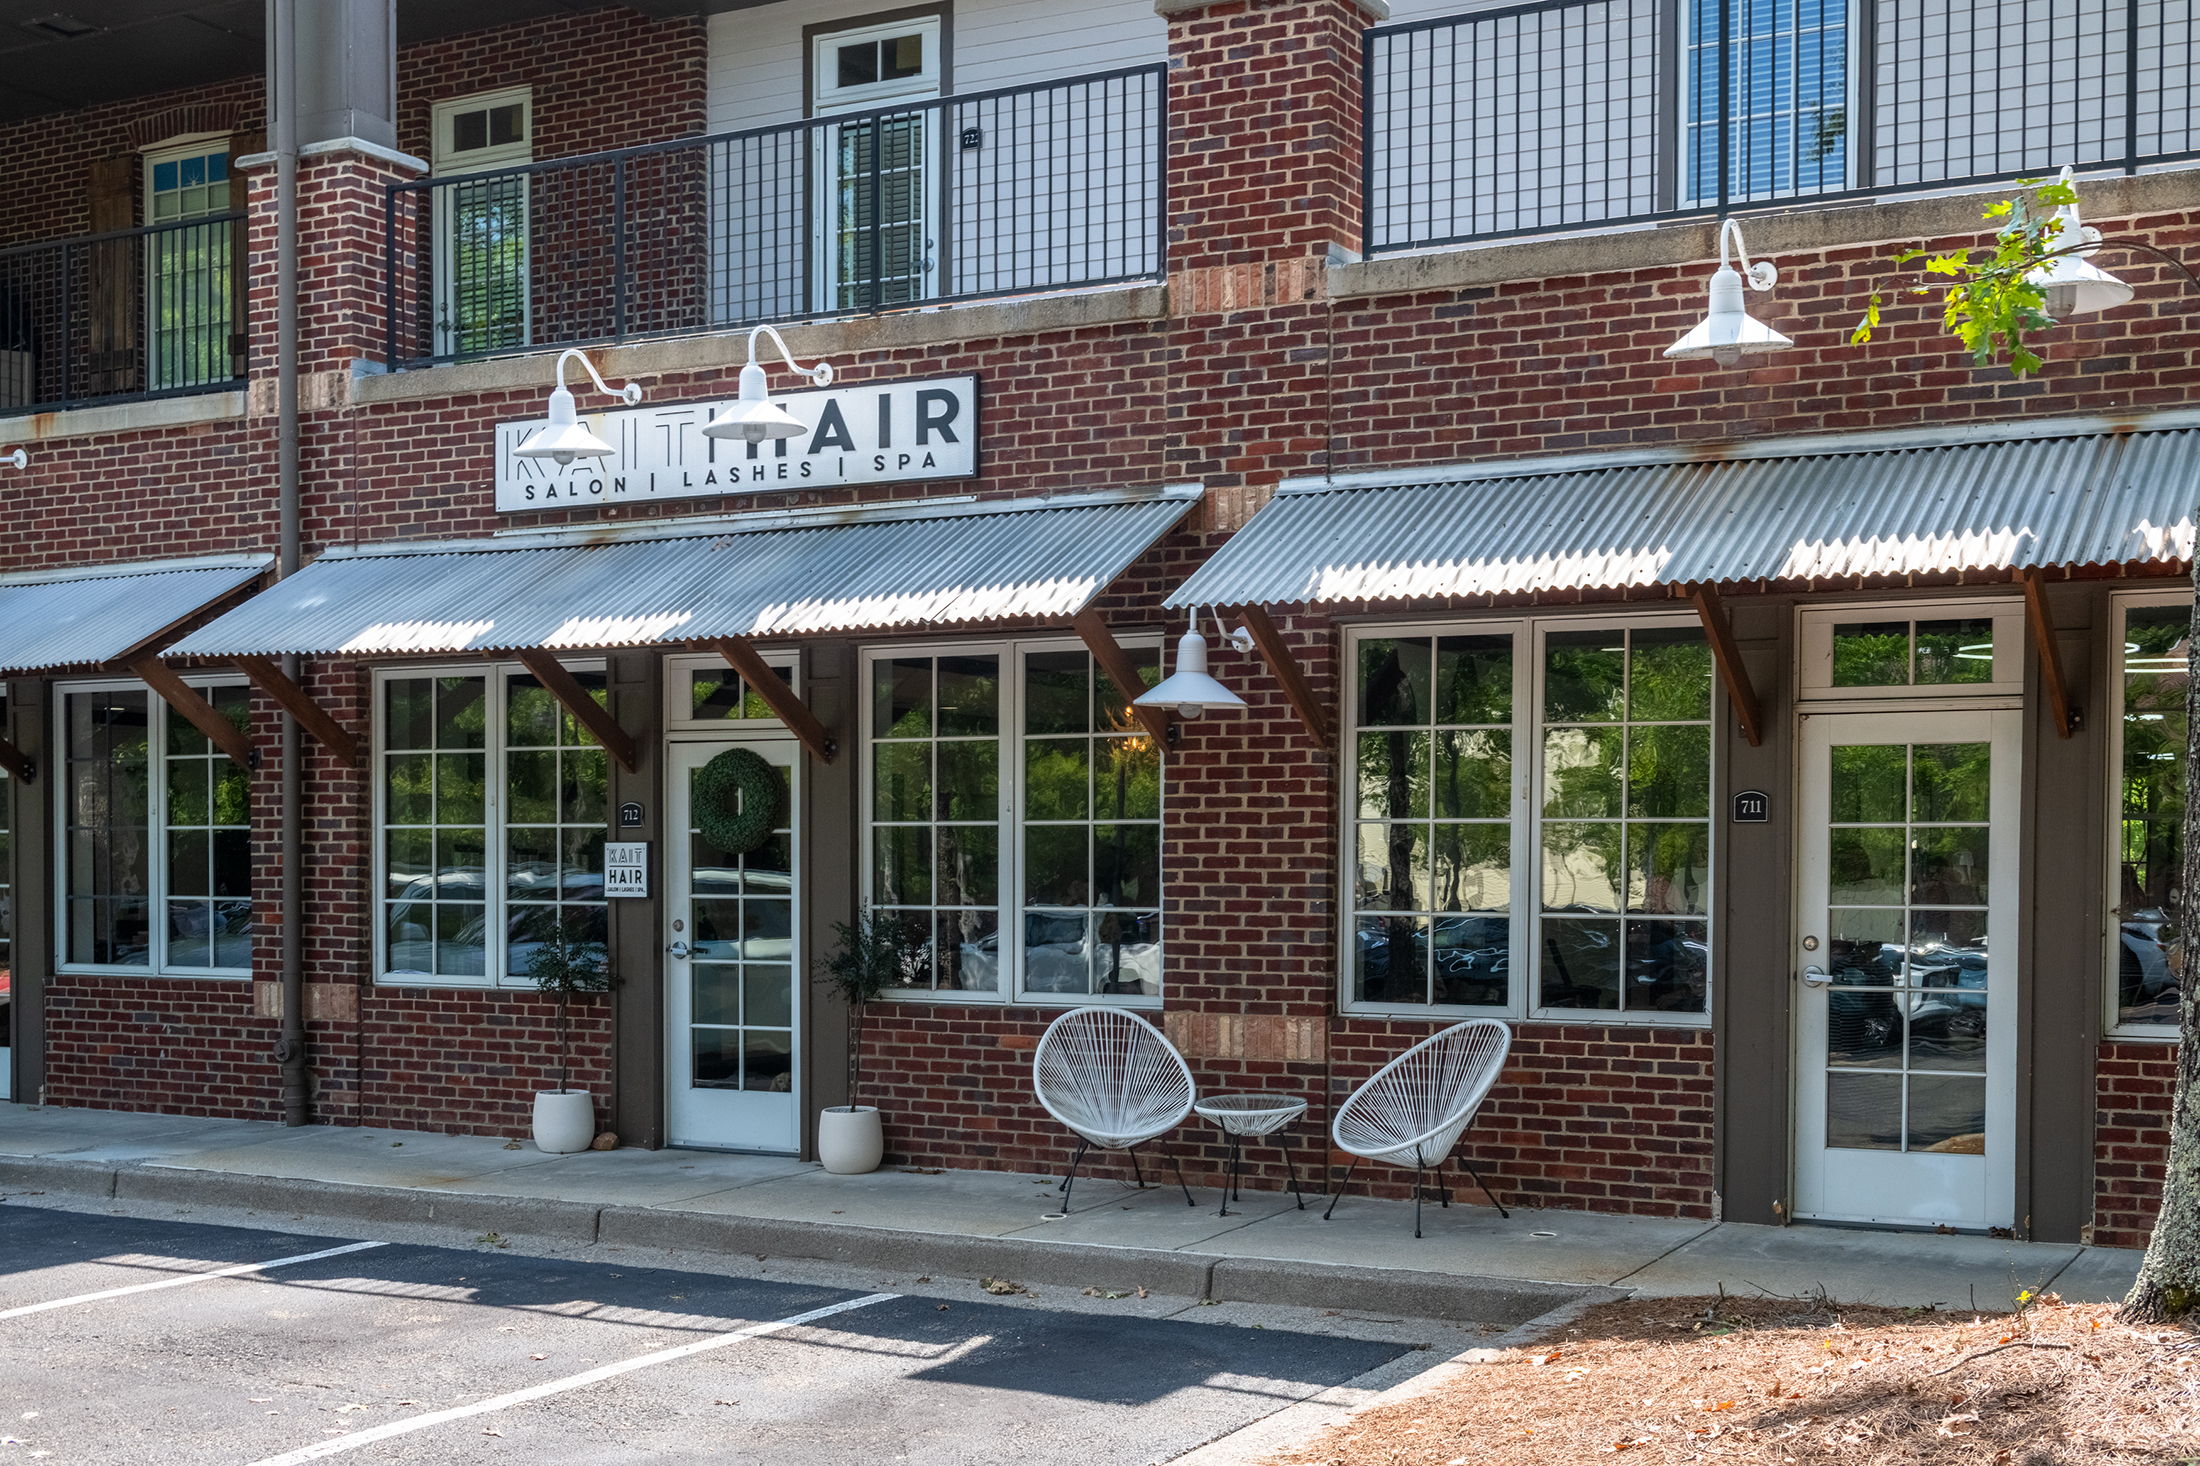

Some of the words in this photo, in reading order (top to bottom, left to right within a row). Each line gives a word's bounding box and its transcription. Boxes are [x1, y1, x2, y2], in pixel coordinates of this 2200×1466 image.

[525, 476, 626, 500] SALON
[683, 460, 812, 488] LASHES
[873, 451, 936, 472] SPA
[1741, 800, 1761, 813] 711
[623, 809, 639, 820] 712
[608, 847, 642, 863] KAIT
[609, 869, 642, 884] HAIR
